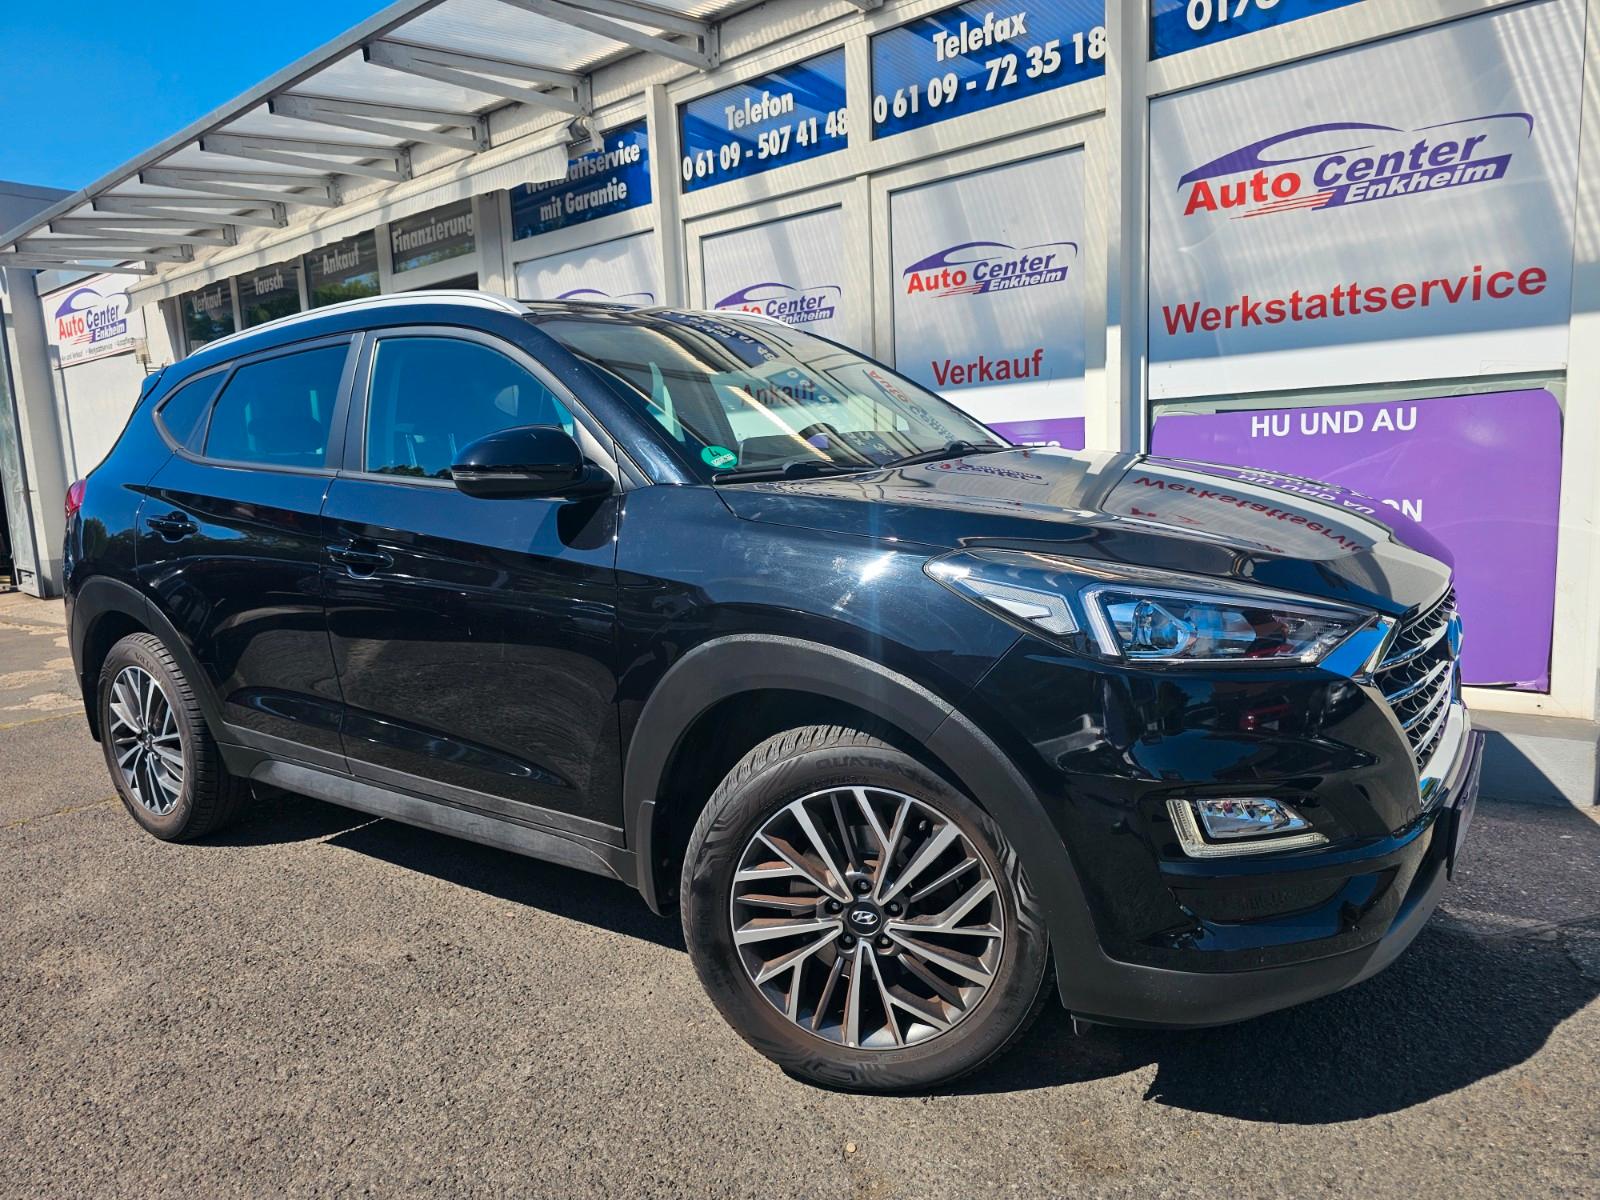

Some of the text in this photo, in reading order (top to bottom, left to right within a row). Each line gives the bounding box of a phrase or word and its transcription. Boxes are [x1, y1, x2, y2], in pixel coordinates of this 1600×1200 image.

[933, 11, 1027, 62] Telefax
[874, 26, 1106, 123] 0 61 09 - 72 35 18
[725, 91, 793, 130] Telefon
[683, 157, 692, 181] 0
[695, 150, 714, 176] 61
[720, 142, 740, 170] 09
[758, 127, 791, 157] 507
[796, 119, 817, 147] 41
[825, 108, 848, 136] 48
[1184, 134, 1488, 216] Auto Center
[1343, 160, 1497, 204] Enkheim
[540, 177, 627, 221] mit Garantie
[392, 211, 474, 254] Finanzierung
[322, 242, 360, 275] Ankauf
[908, 252, 1056, 294] Auto Center
[254, 269, 283, 295] Tausch
[988, 269, 1063, 292] Enkheim
[766, 295, 826, 316] Center
[779, 309, 831, 323] Enkheim
[1162, 265, 1547, 336] Werkstattservice
[58, 304, 119, 340] Auto Center
[95, 322, 126, 339] Enkheim
[932, 348, 1044, 386] Verkauf
[1252, 406, 1417, 438] HU UND AU
